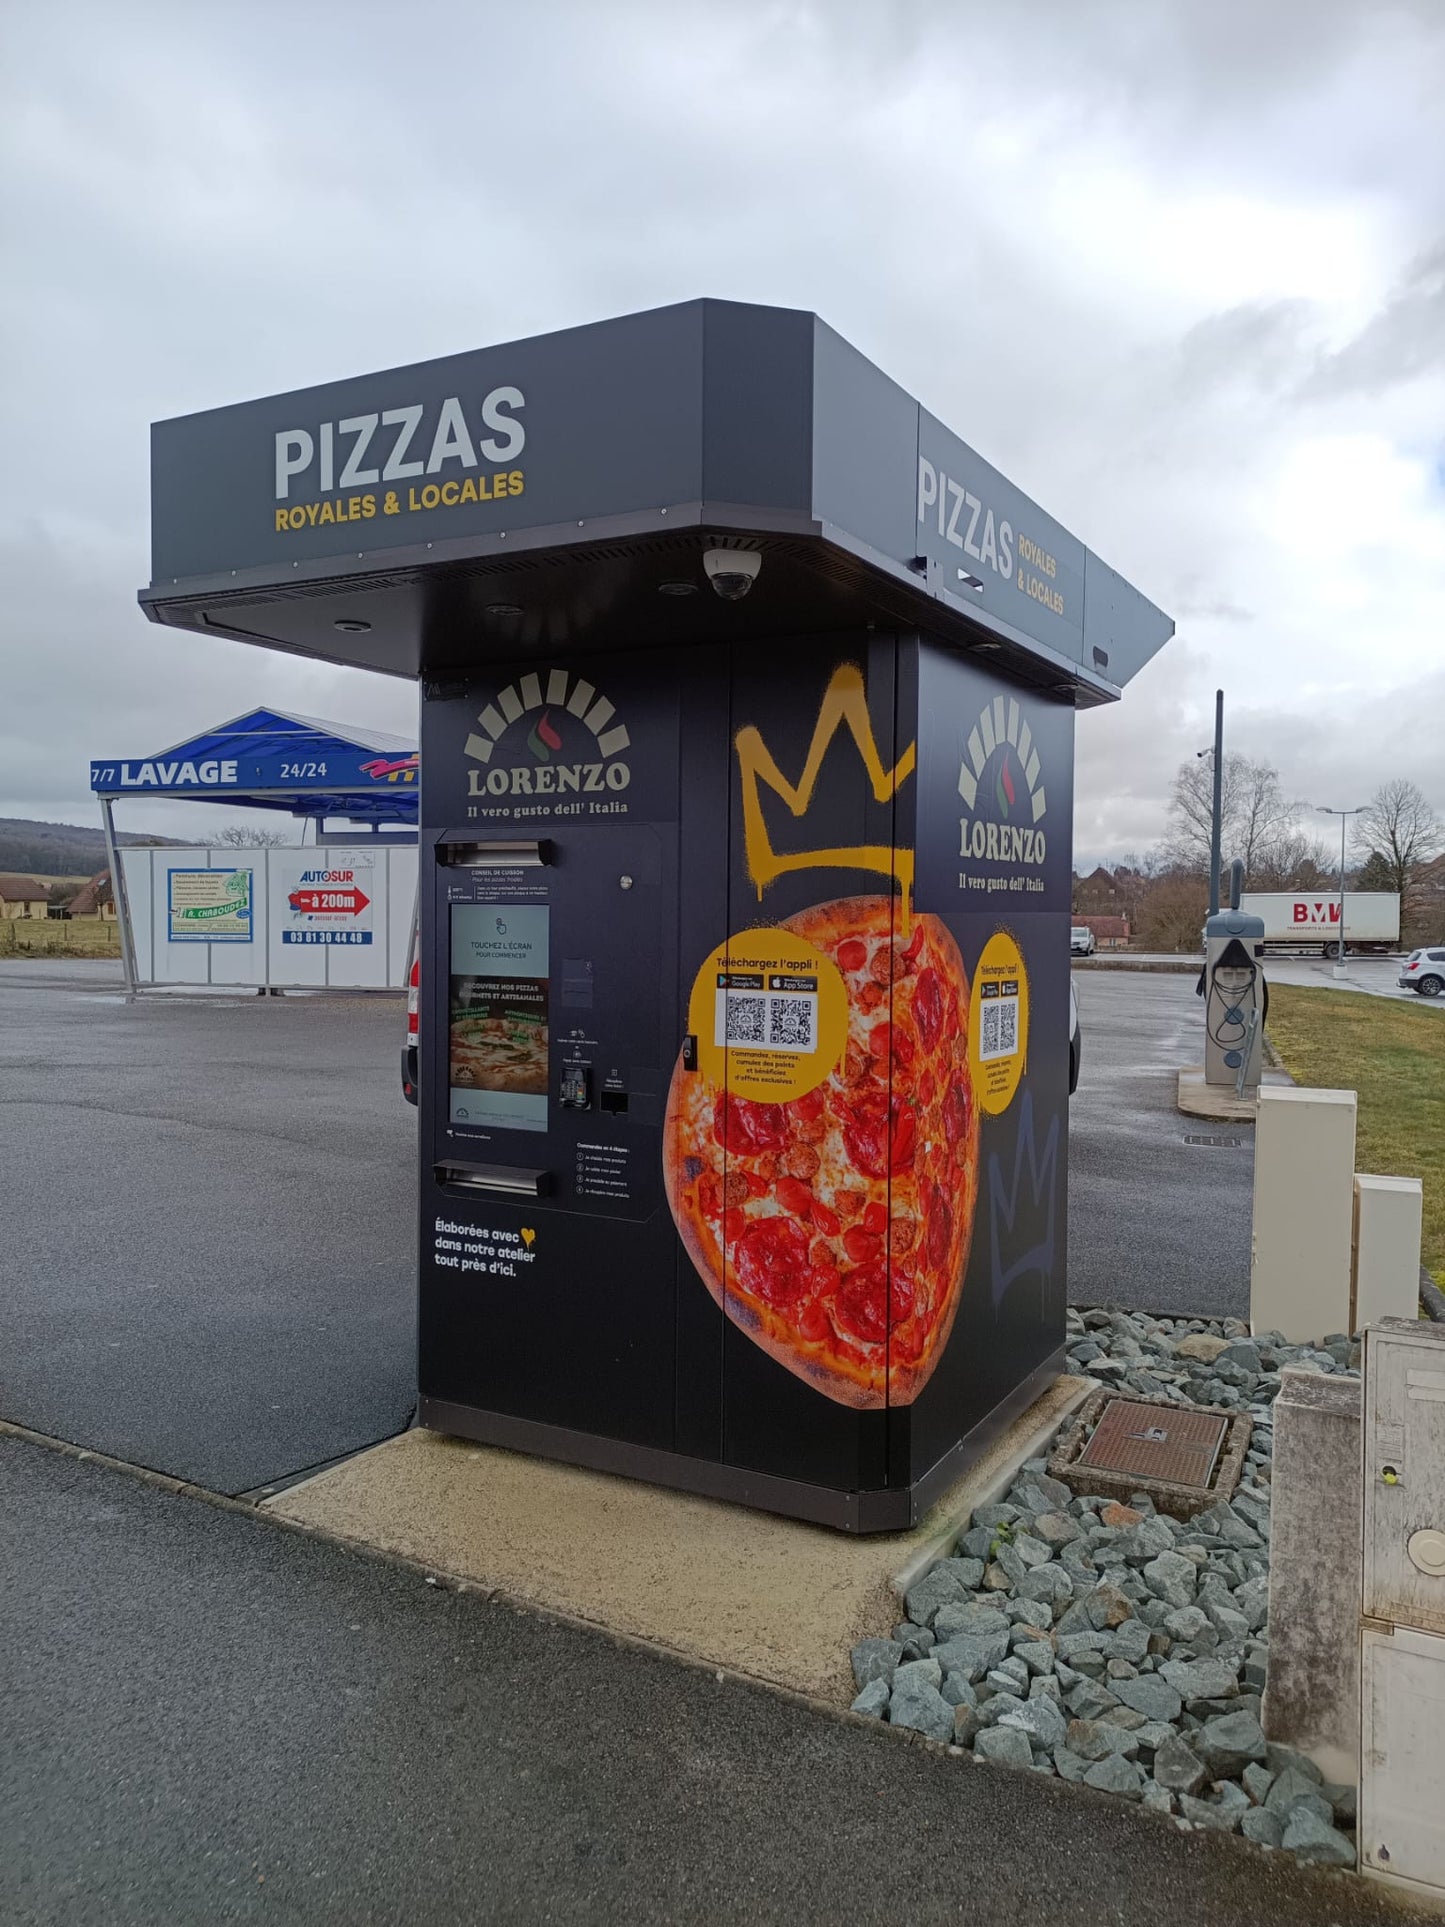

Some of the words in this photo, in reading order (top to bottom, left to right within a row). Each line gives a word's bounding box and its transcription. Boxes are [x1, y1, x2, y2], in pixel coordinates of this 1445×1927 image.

[275, 386, 526, 500] PIZZAS
[275, 494, 376, 532] ROYALES
[384, 491, 400, 515] &
[409, 470, 524, 511] LOCALES
[918, 455, 1014, 580] PIZZAS
[1018, 533, 1056, 579] ROYALES
[1017, 568, 1024, 591] &
[1027, 574, 1064, 616] LOCALES
[91, 769, 115, 783] 7/7
[120, 760, 238, 786] LAVAGE
[280, 762, 328, 779] 24/24
[467, 762, 631, 796] LORENZO
[467, 806, 477, 818] Il
[481, 808, 510, 817] vero
[514, 805, 550, 819] gusto
[554, 803, 585, 815] dell'
[589, 801, 628, 814] Italia
[959, 818, 1046, 865] LORENZO
[300, 870, 353, 882] AUTOSUR
[959, 873, 966, 889] Il
[968, 877, 985, 889] vero
[987, 877, 1007, 893] gusto
[1009, 876, 1026, 891] dell'
[1026, 877, 1044, 892] Italia
[198, 899, 246, 917] CHABOUDEZ
[312, 893, 319, 908] à
[321, 893, 355, 908] 200m
[290, 932, 303, 942] 03
[320, 932, 332, 943] 30
[335, 932, 347, 943] 44
[471, 941, 502, 950] TOUCHEZ
[717, 957, 778, 971] Téléchargez
[780, 959, 812, 971] l'appli
[784, 981, 797, 990] App
[797, 982, 813, 990] Store
[435, 1216, 489, 1239] Élaborées
[492, 1230, 519, 1243] avec
[435, 1237, 462, 1251] dans
[464, 1243, 495, 1256] notre
[498, 1247, 536, 1262] atelier
[434, 1253, 459, 1267] tout
[461, 1258, 487, 1272] près
[489, 1261, 517, 1277] d'ici.
